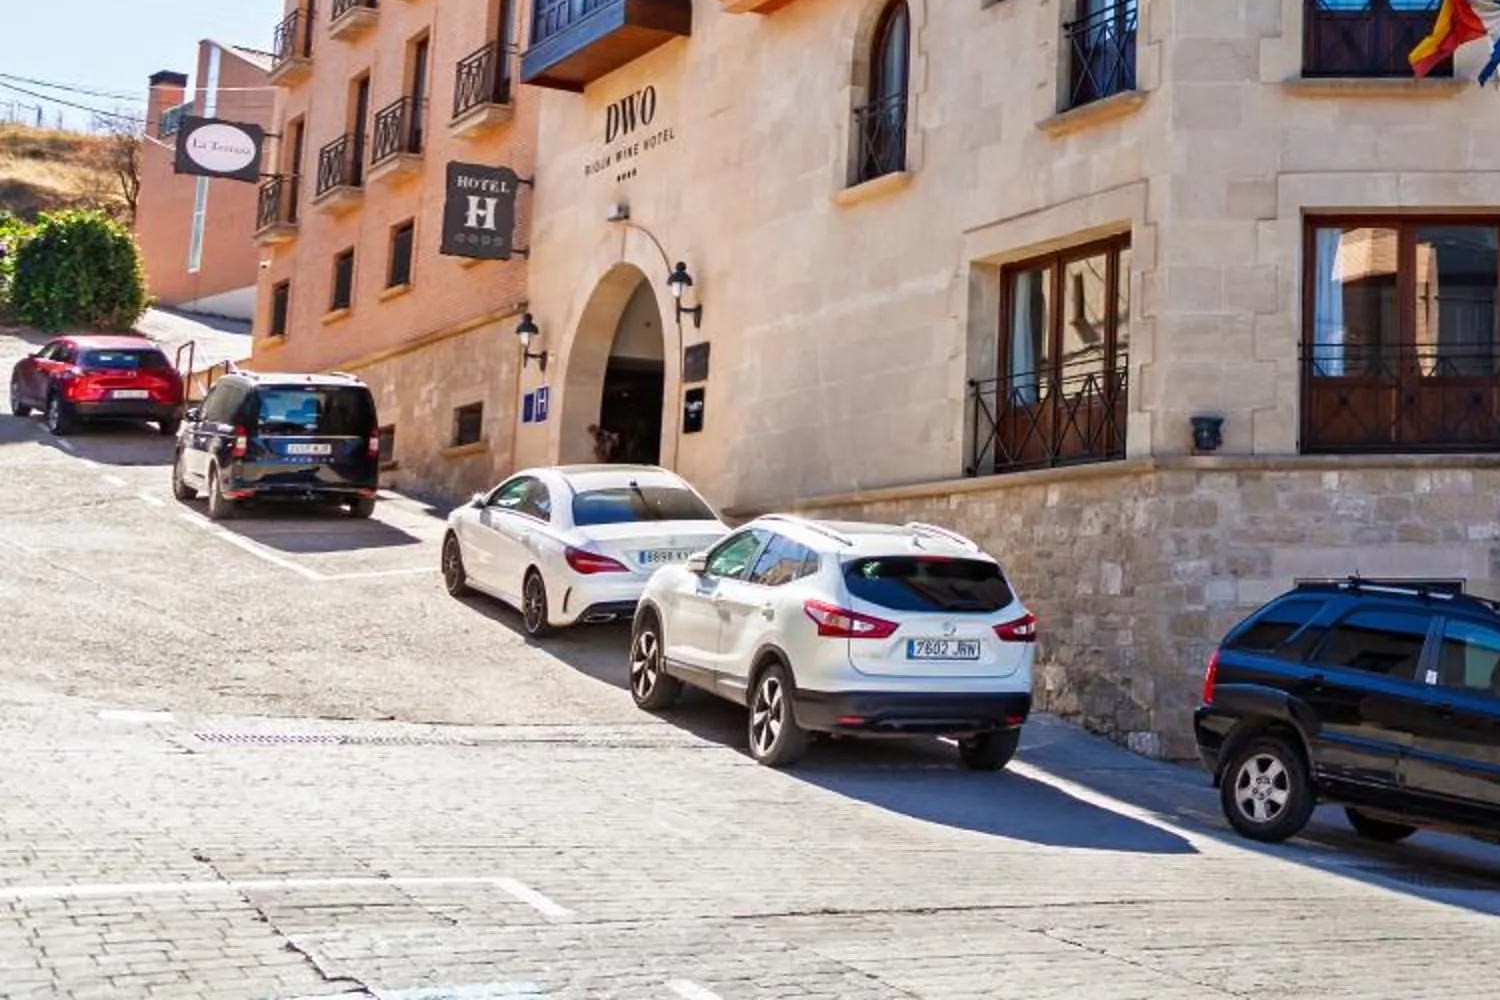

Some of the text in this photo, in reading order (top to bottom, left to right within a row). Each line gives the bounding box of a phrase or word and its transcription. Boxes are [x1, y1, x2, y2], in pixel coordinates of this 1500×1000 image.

[605, 85, 656, 144] DWO
[616, 143, 639, 163] WINE
[644, 127, 675, 151] HOTEL
[456, 175, 511, 193] HOTEL
[463, 195, 499, 231] H
[916, 640, 949, 656] 7602
